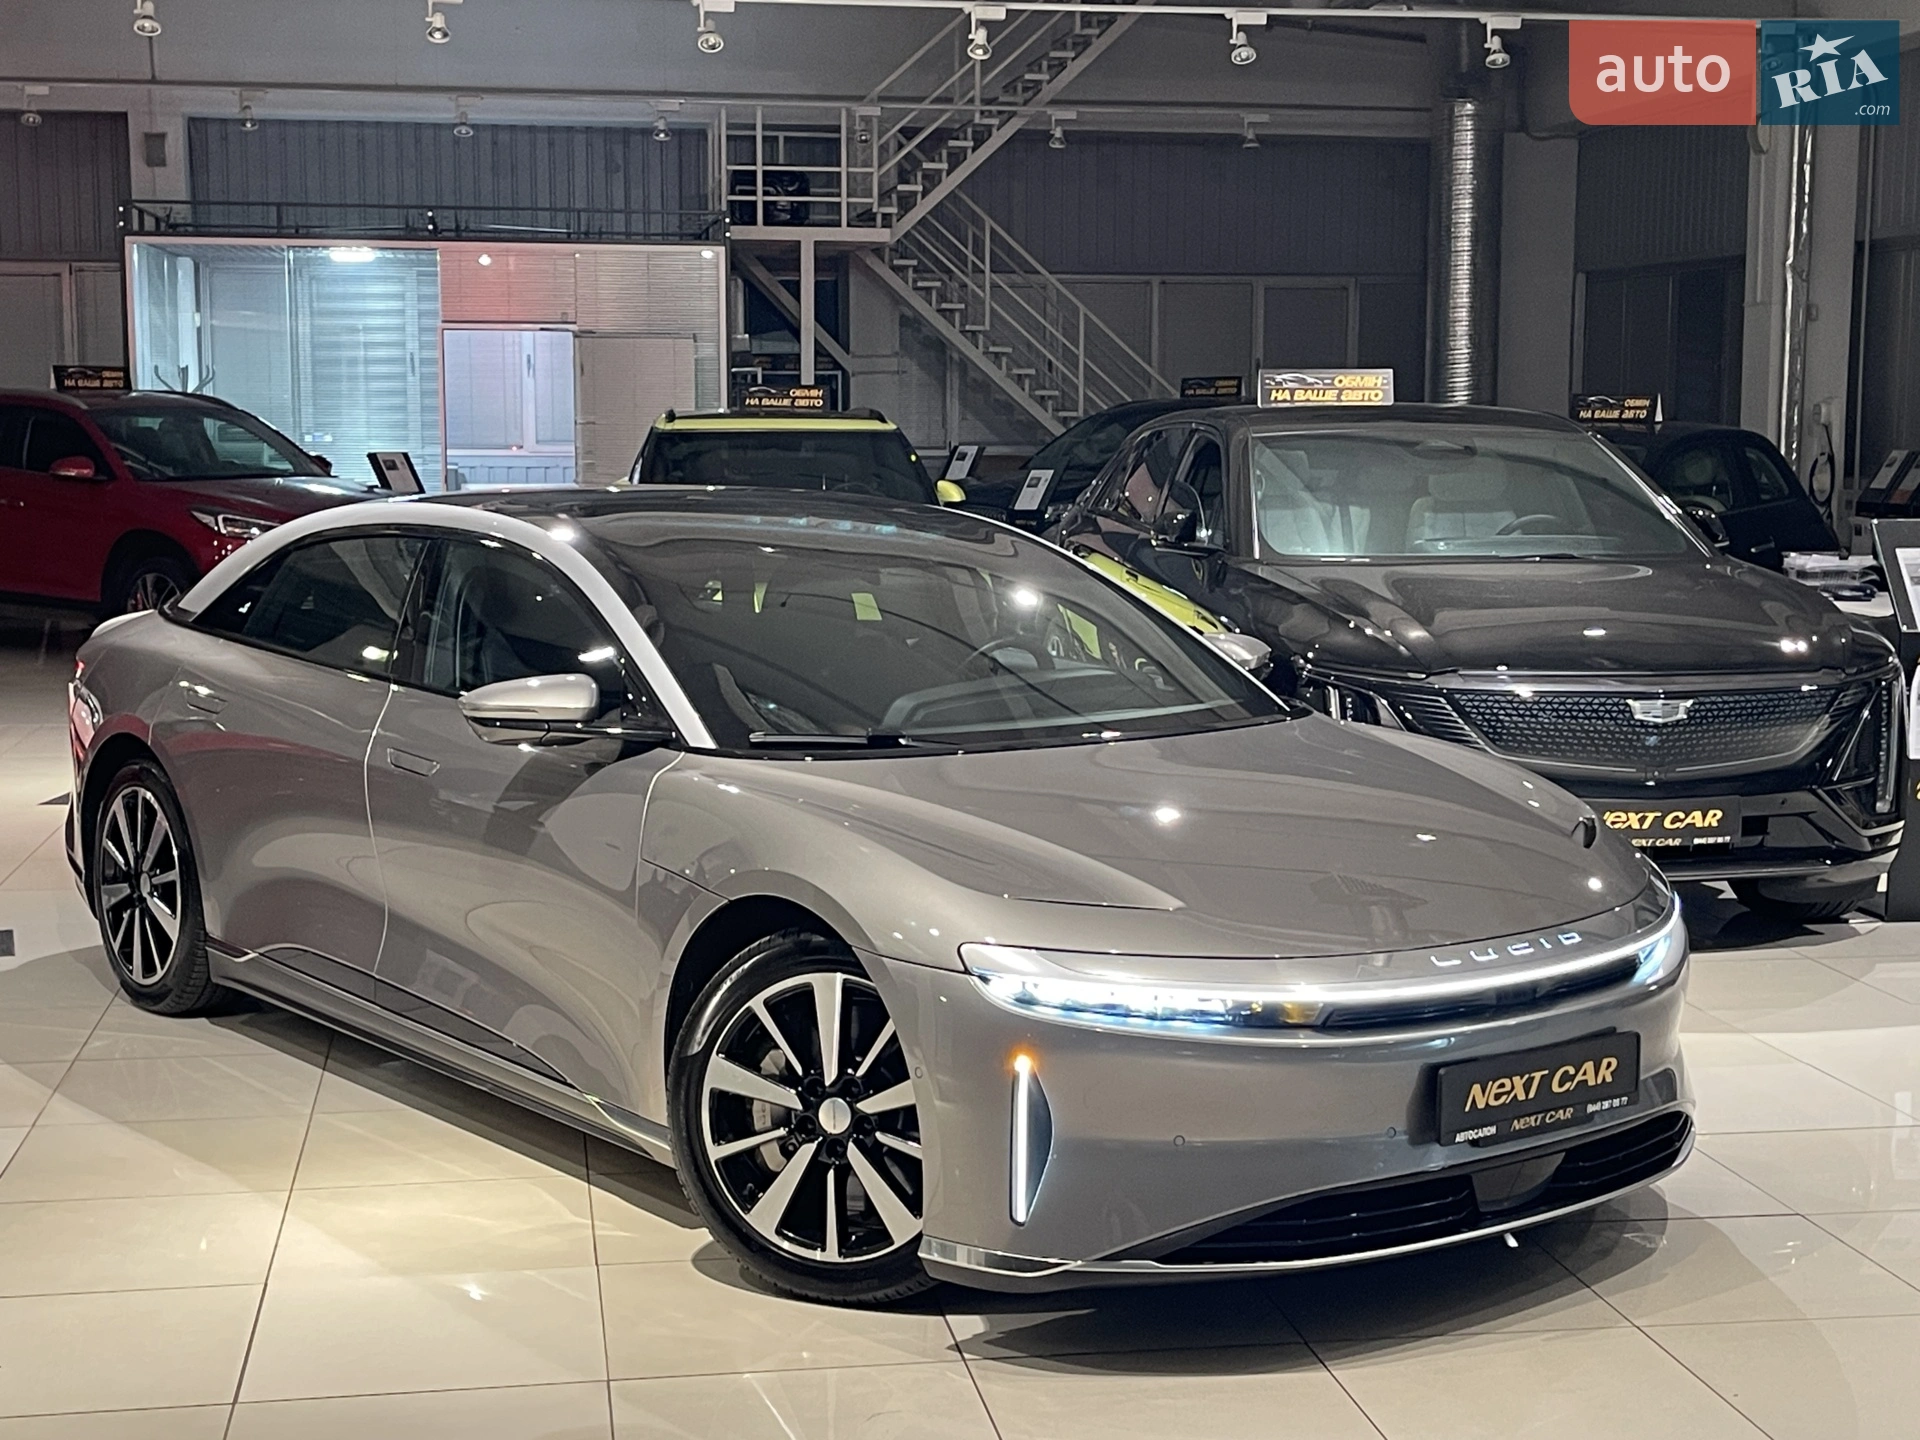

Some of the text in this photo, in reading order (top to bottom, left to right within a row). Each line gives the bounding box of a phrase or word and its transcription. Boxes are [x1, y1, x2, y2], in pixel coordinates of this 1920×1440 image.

[745, 398, 759, 406] НА
[1270, 389, 1291, 401] НА
[1293, 389, 1339, 401] ВАШЕ
[1663, 808, 1723, 830] CAR
[1655, 838, 1682, 847] CAR
[1429, 931, 1583, 968] LUCID
[1551, 1056, 1619, 1095] CAR
[1545, 1107, 1574, 1124] CAR
